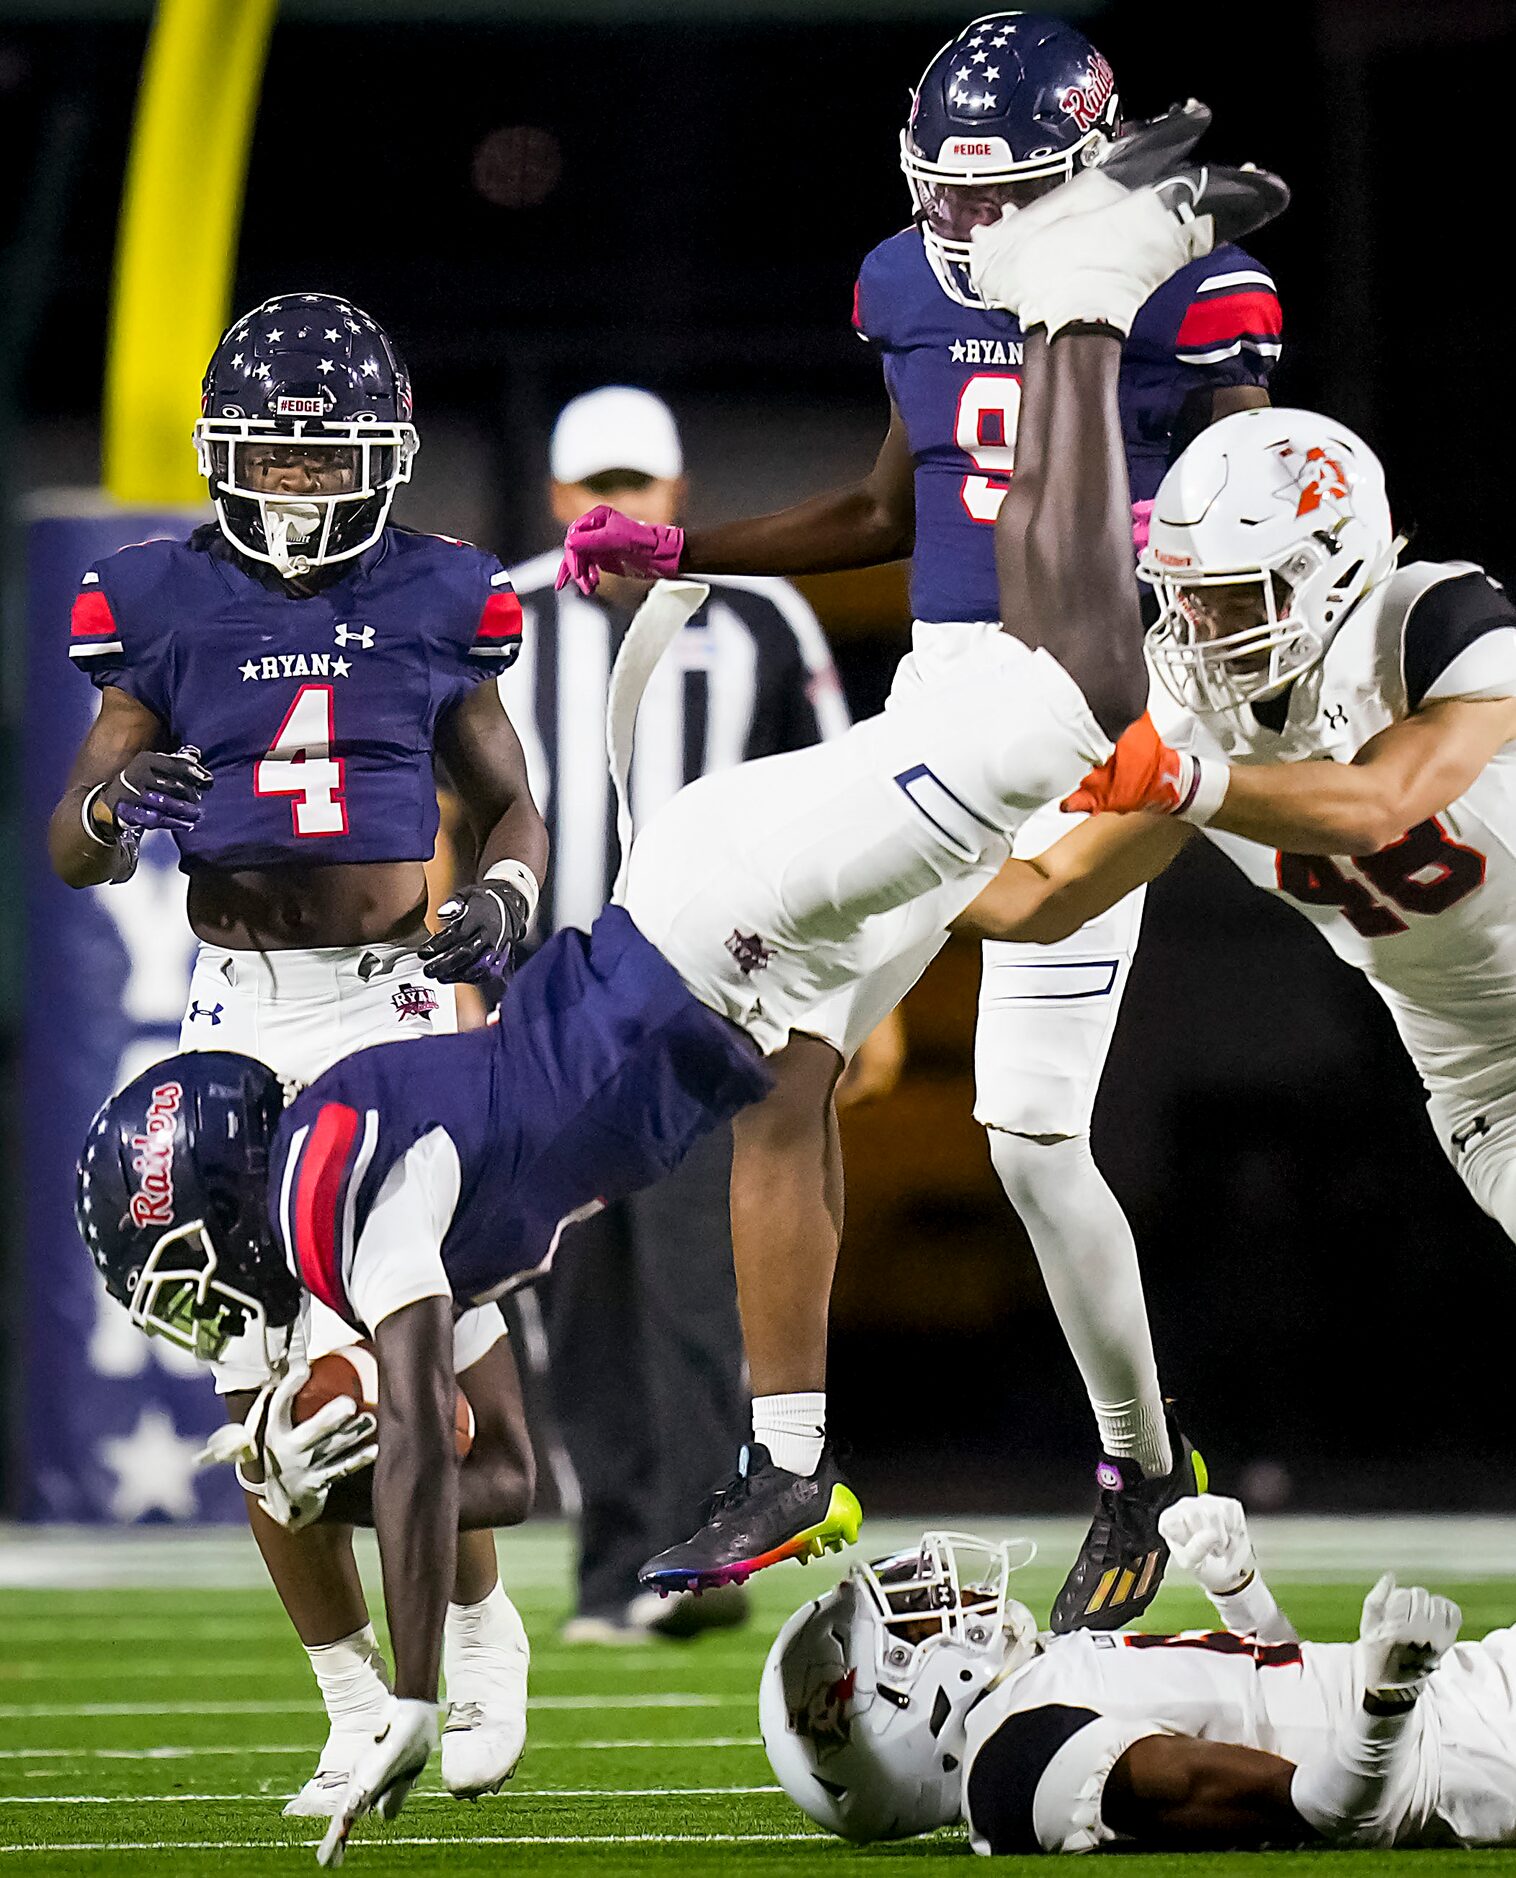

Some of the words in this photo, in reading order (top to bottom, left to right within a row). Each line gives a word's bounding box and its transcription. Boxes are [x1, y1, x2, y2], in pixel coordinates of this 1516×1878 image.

[953, 143, 992, 156] #EDGE
[965, 339, 1024, 365] RYAN
[280, 400, 321, 413] #EDGE
[953, 372, 1022, 524] 9
[261, 653, 331, 679] RYAN
[254, 684, 349, 838] 4
[1274, 815, 1487, 938] 48
[130, 1081, 184, 1228] Raiders
